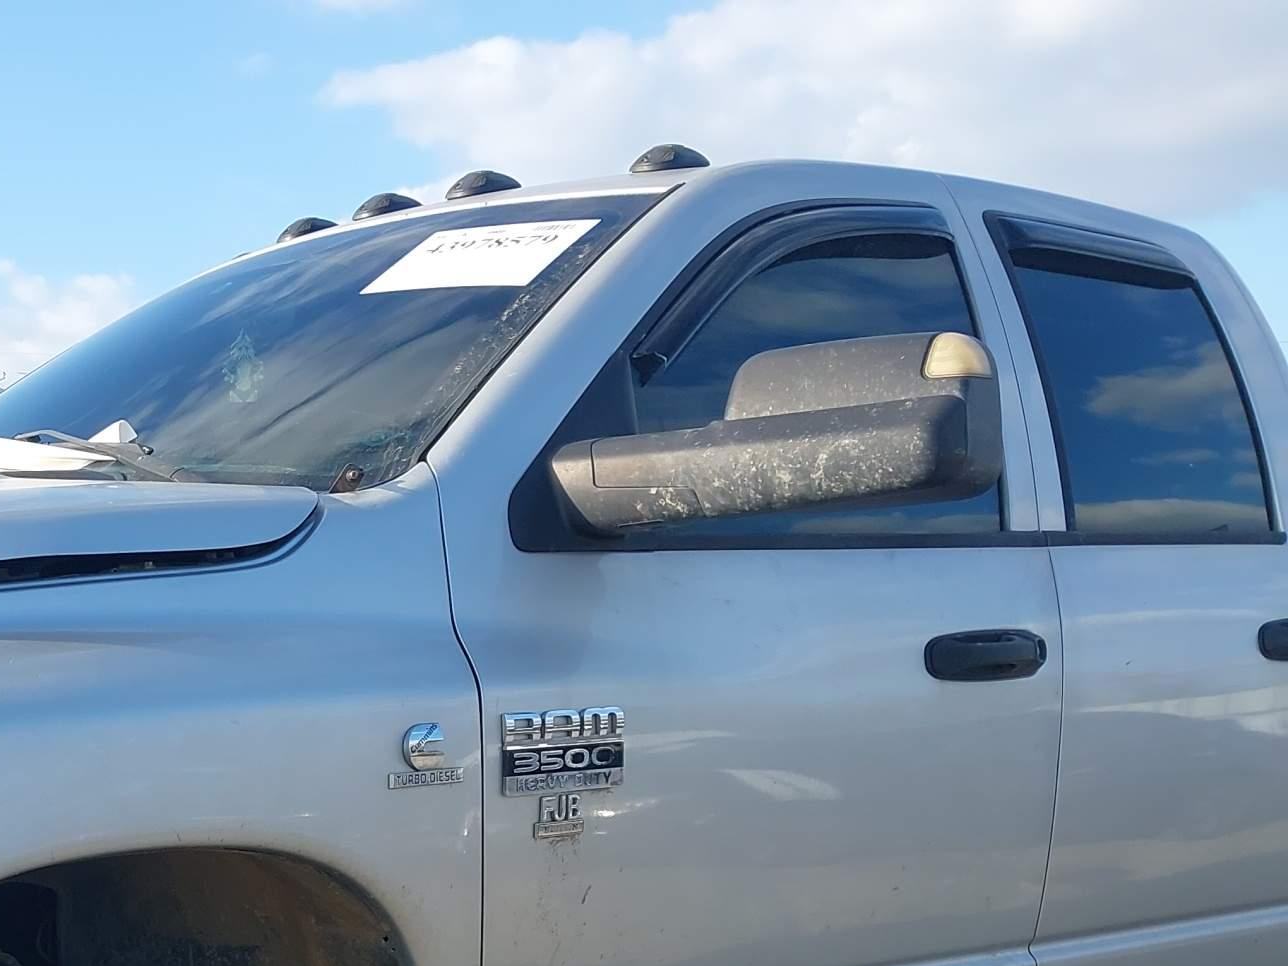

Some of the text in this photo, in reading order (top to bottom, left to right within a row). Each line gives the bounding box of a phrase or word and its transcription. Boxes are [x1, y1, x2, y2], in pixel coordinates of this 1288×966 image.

[502, 707, 624, 741] RAM
[396, 769, 463, 786] TURBO DIESEL
[516, 771, 612, 793] HEAVY DUTY
[540, 794, 581, 820] FJB
